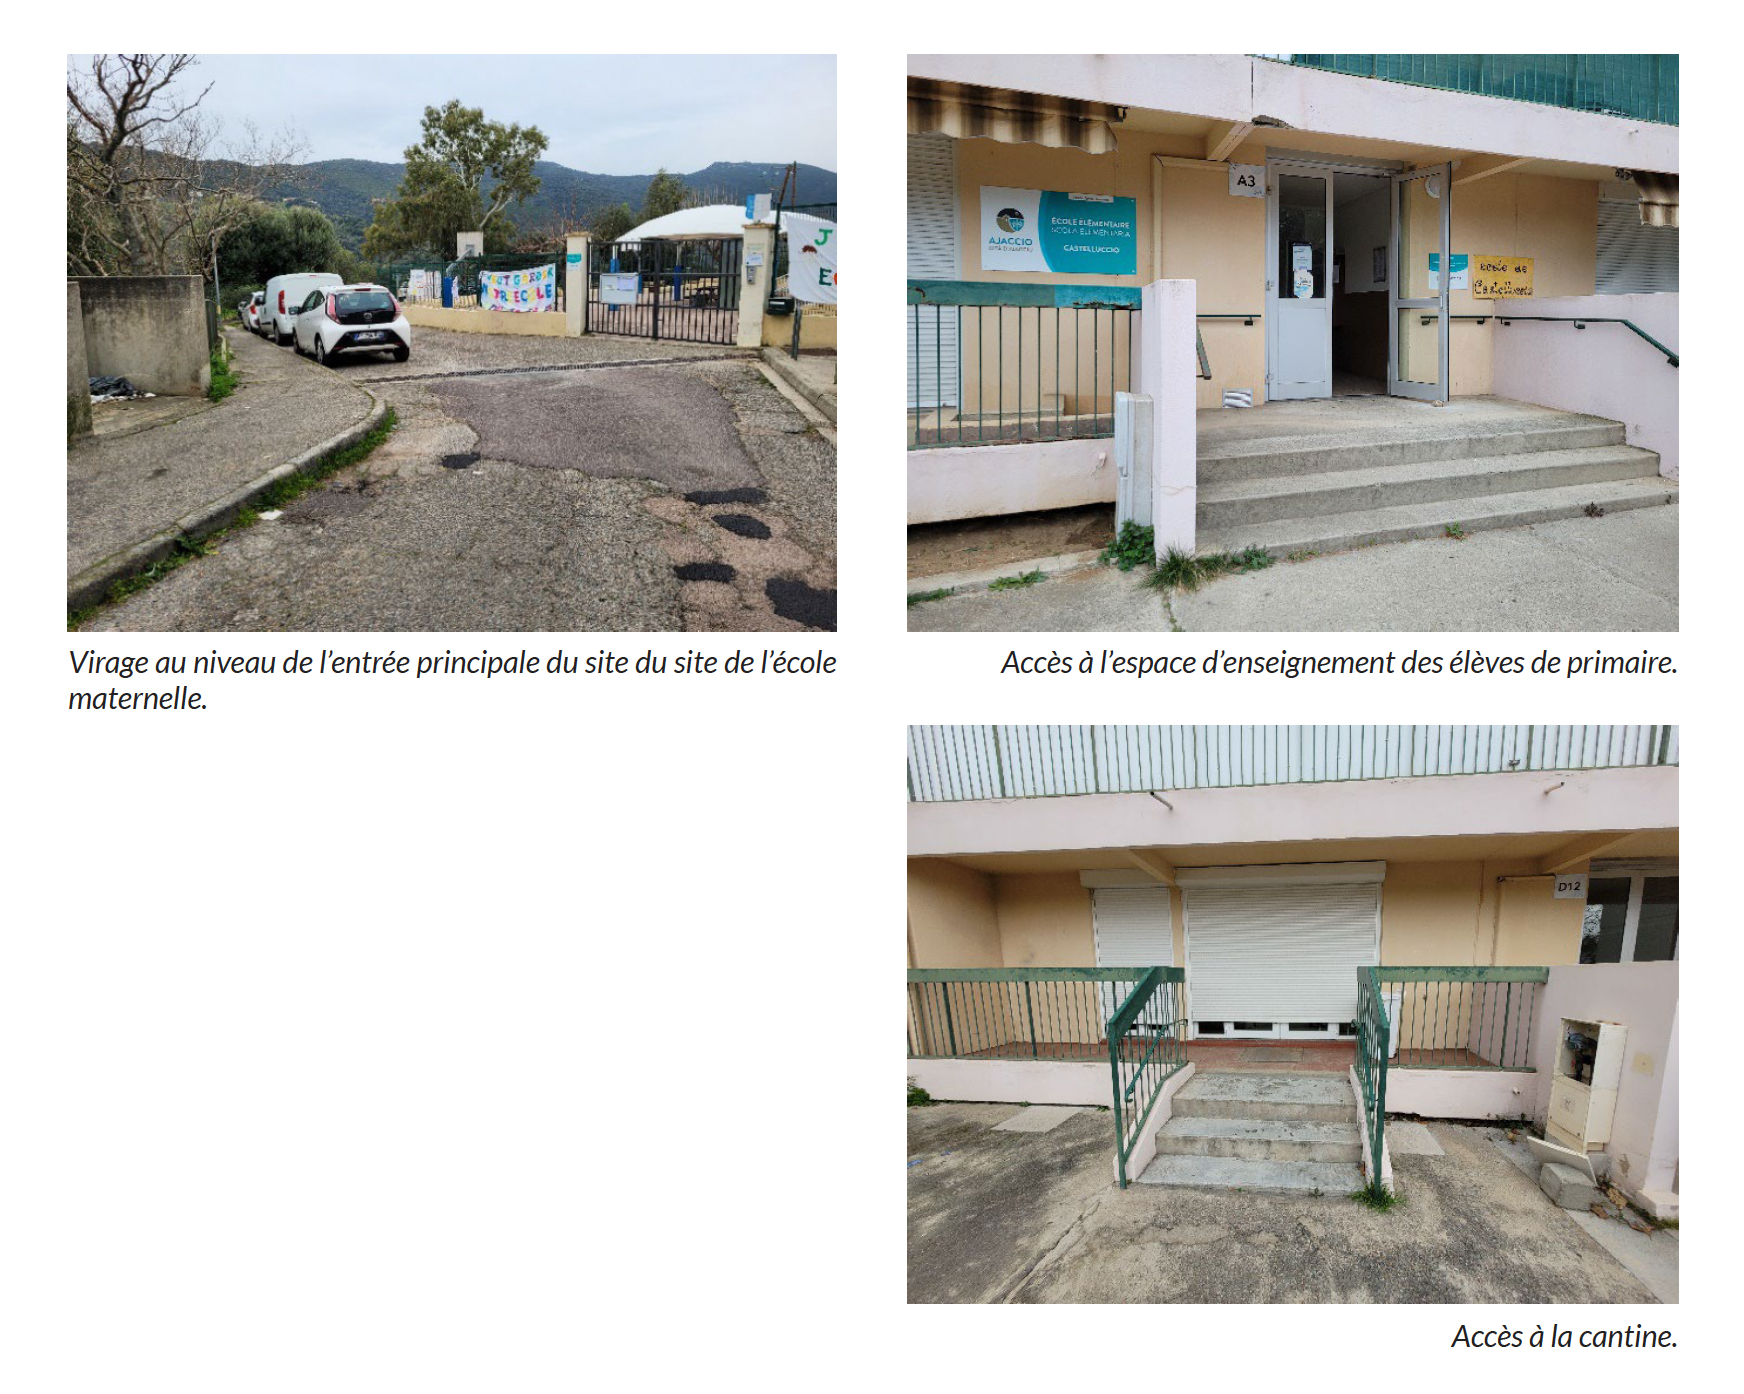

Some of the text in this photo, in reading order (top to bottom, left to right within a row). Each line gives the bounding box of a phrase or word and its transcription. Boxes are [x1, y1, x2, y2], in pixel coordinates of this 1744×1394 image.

[1237, 174, 1256, 187] A3
[814, 228, 834, 246] J
[988, 236, 1033, 246] AJACCIO
[1063, 244, 1121, 254] CASTELLUCCIO
[1558, 881, 1581, 892] D12
